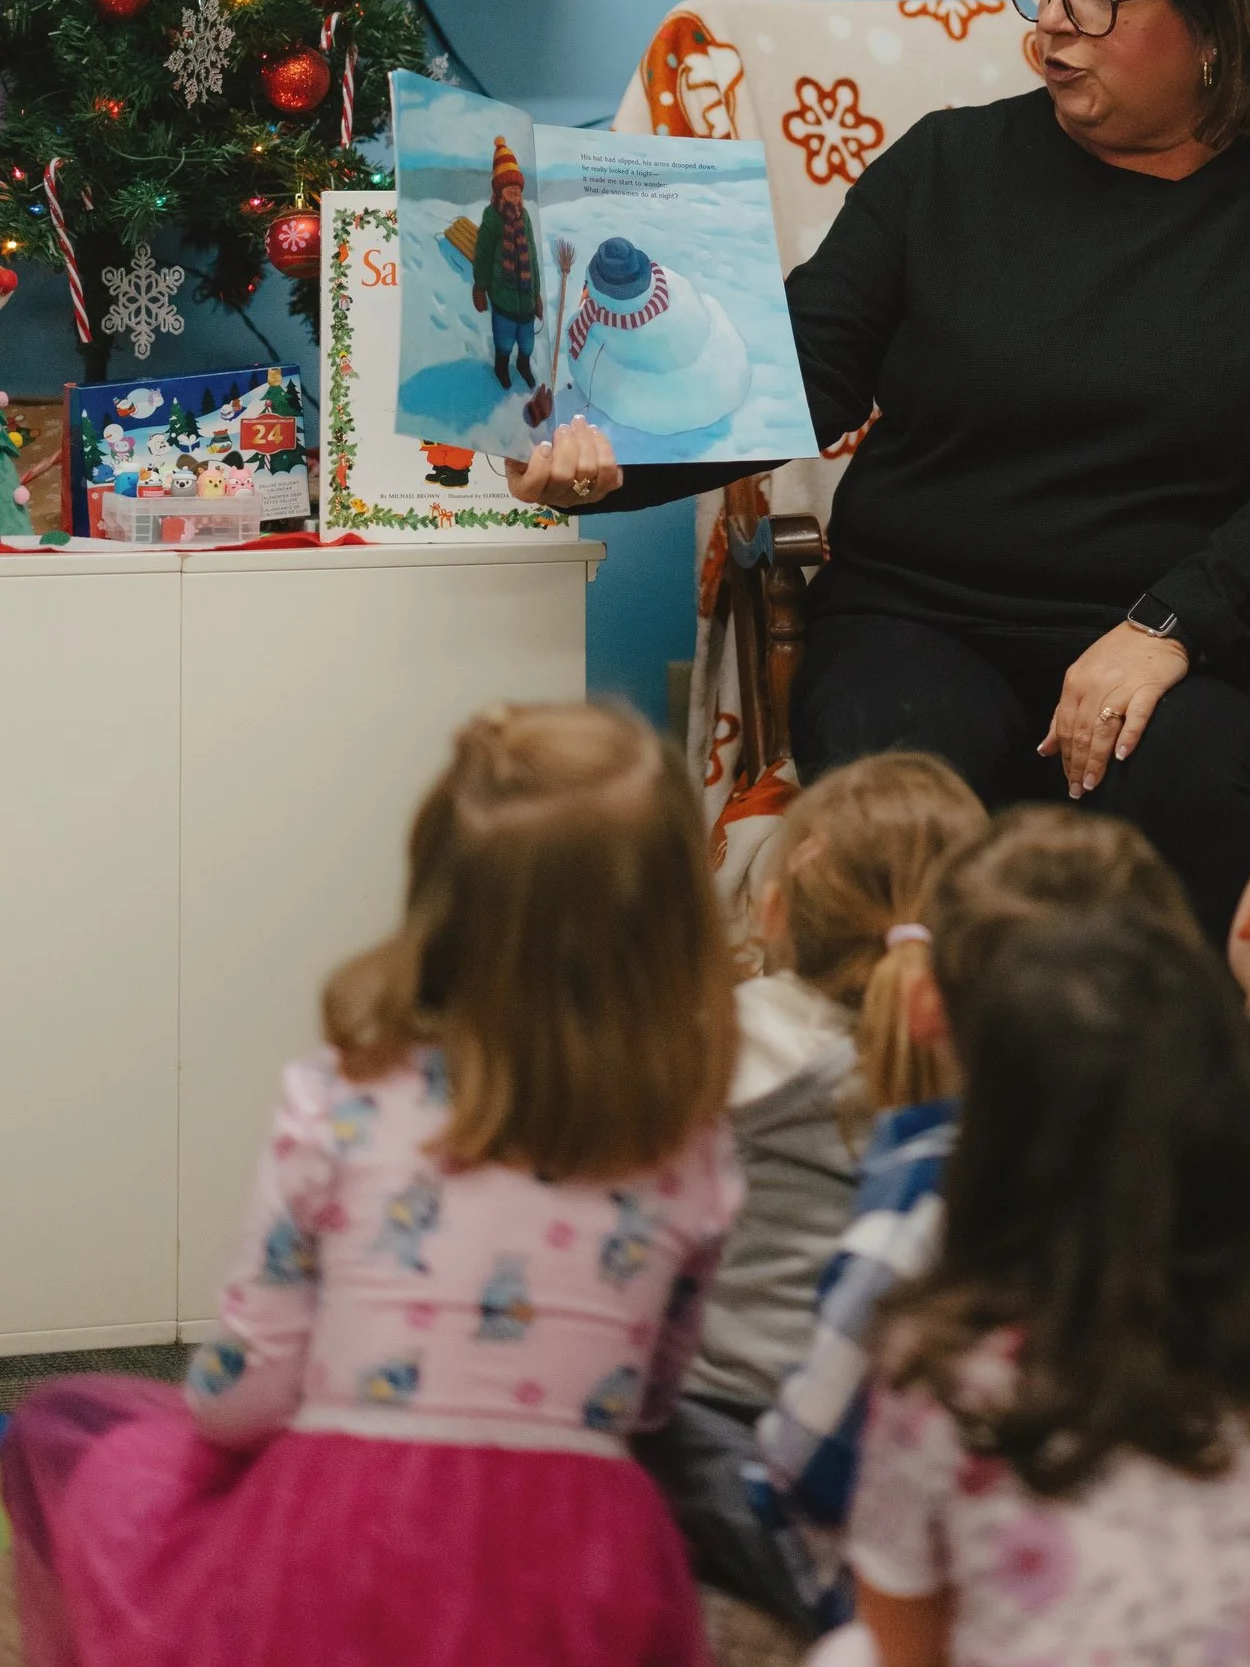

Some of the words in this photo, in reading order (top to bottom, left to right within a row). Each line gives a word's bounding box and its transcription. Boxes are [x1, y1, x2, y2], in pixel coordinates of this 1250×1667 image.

[618, 157, 640, 166] slipped,
[671, 161, 696, 170] drooped
[591, 166, 607, 174] really
[609, 167, 629, 175] looked
[611, 189, 639, 197] snowmen
[640, 190, 648, 198] do
[658, 193, 679, 201] night?
[361, 249, 398, 286] Sa
[252, 424, 283, 444] 24
